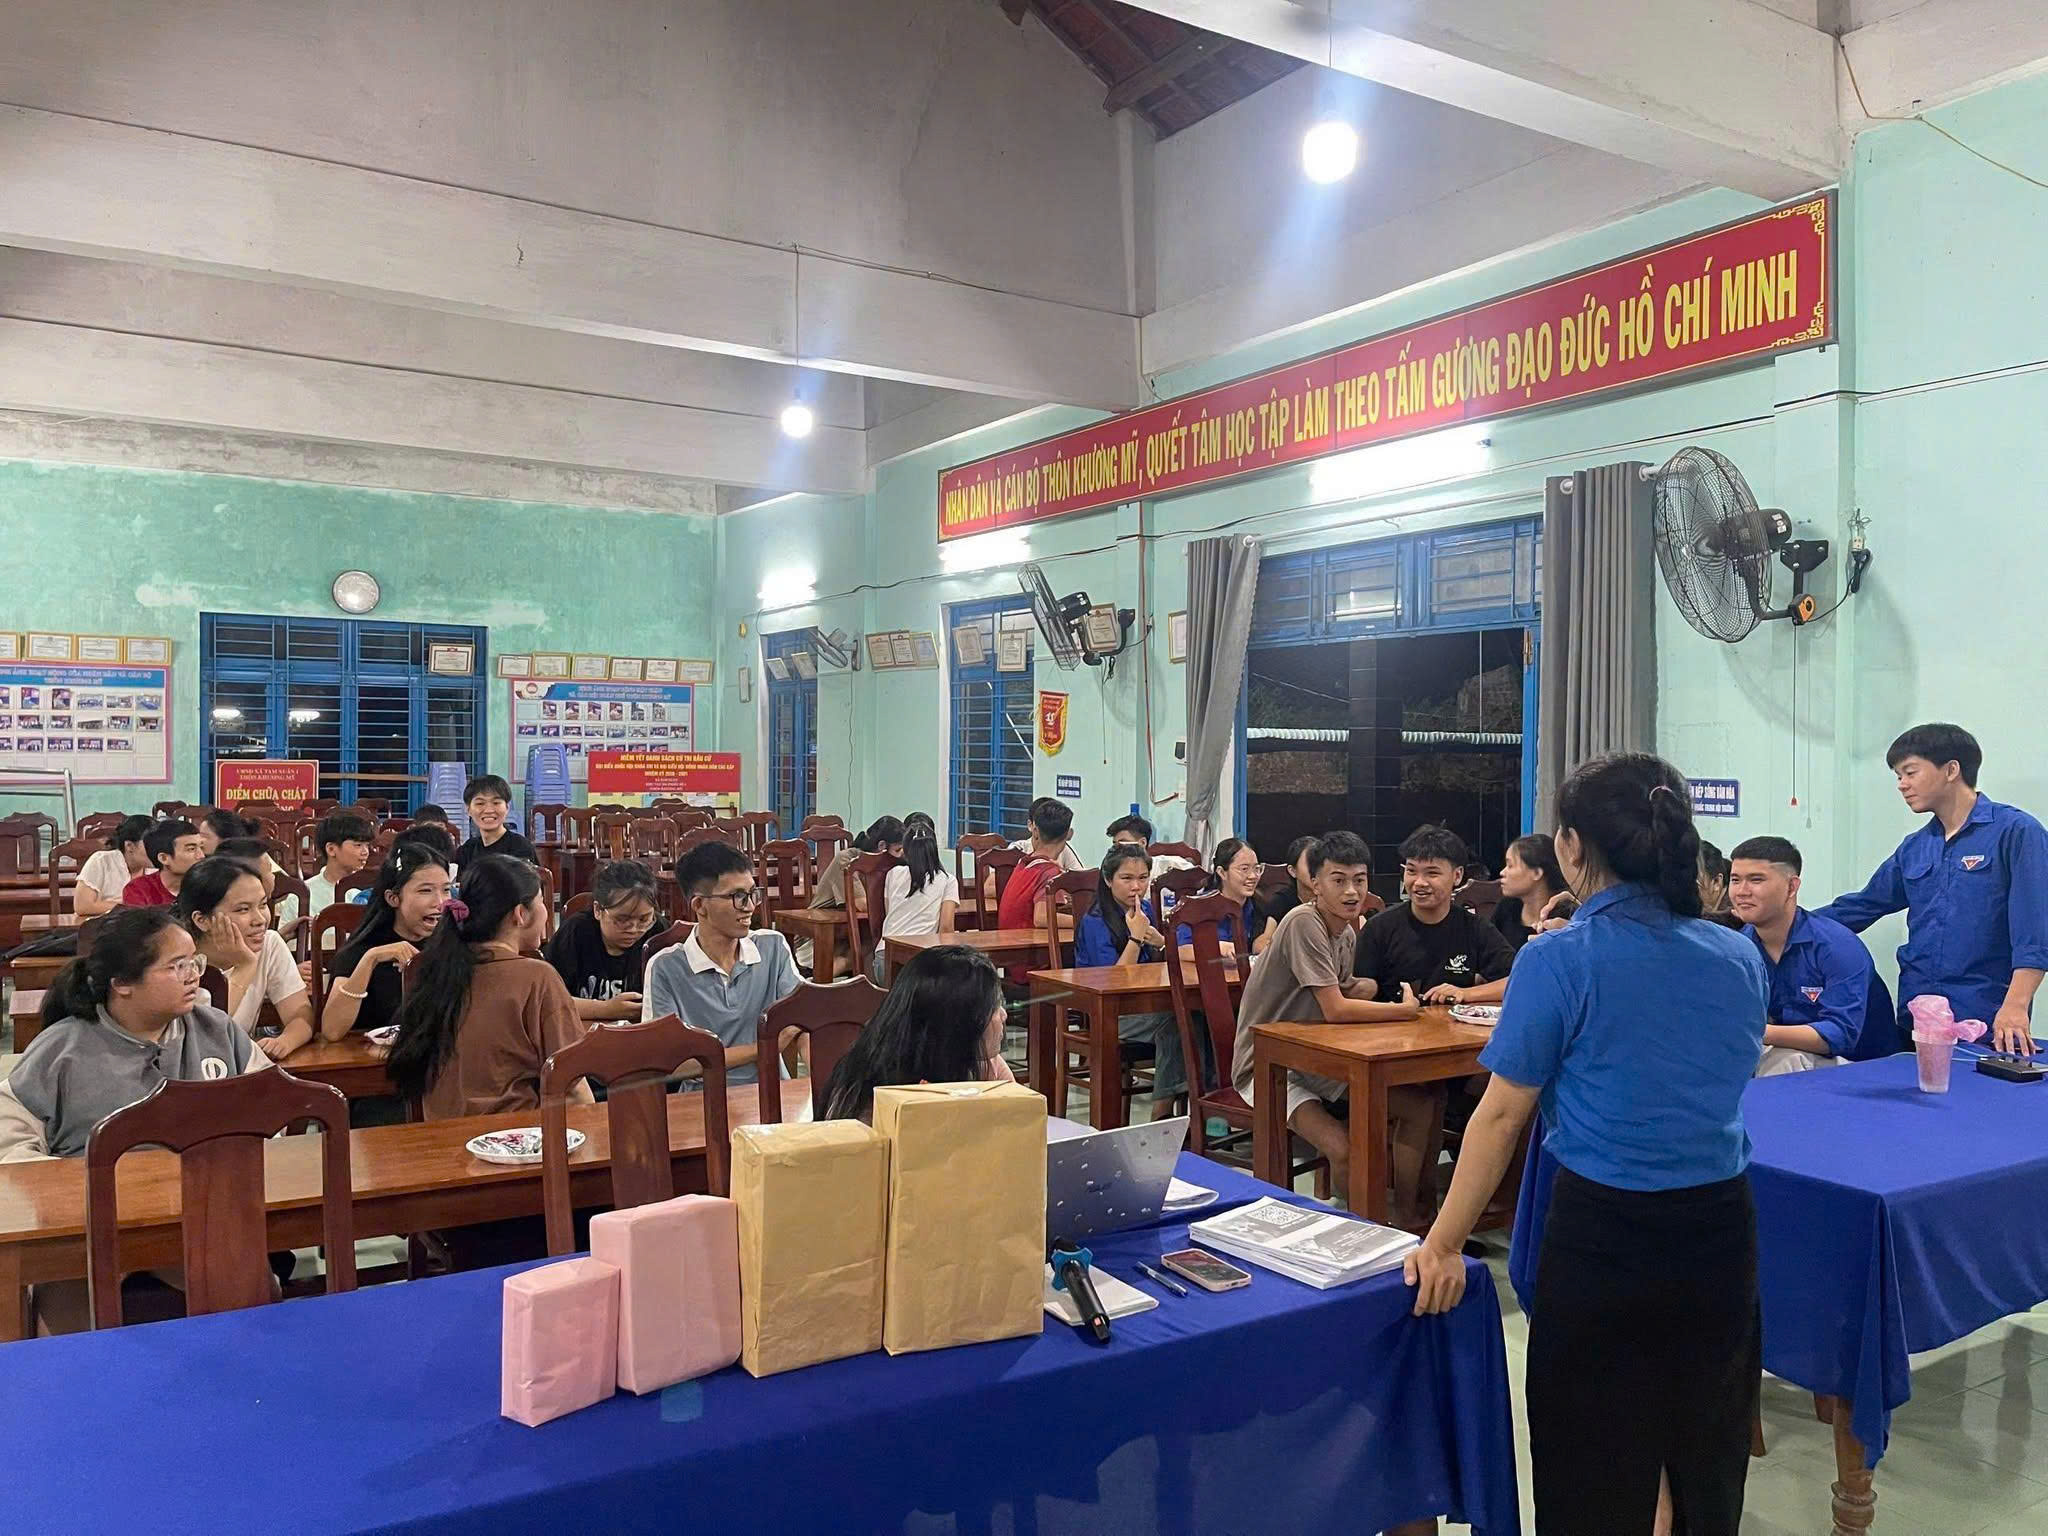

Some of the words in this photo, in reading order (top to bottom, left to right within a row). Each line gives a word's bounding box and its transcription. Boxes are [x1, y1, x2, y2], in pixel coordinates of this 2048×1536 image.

[945, 479, 969, 525] NHÂN
[970, 474, 989, 521] DÂN
[991, 468, 1002, 514] VÀ
[1005, 463, 1024, 513] CÁN
[1026, 457, 1040, 513] BỘ
[1042, 450, 1070, 504] THÔN
[1073, 443, 1118, 496] KHƯƠNG
[1120, 431, 1143, 490] MỸ,
[1146, 409, 1187, 486] QUYẾT
[1191, 407, 1221, 468] TÂM
[1225, 407, 1255, 467] HỌC
[1259, 387, 1289, 459] TẬP
[1294, 377, 1329, 443] LÀM
[1333, 371, 1380, 432] THEO
[1385, 340, 1427, 420] TẤM
[1431, 335, 1500, 409] GƯƠNG
[1505, 321, 1552, 398] ĐẠO
[1560, 293, 1610, 377] ĐỨC
[1618, 263, 1655, 363] HỒ
[1663, 256, 1713, 350] CHÍ
[1720, 249, 1798, 336] MINH
[252, 786, 279, 800] CHỮA
[281, 786, 308, 800] CHÁY
